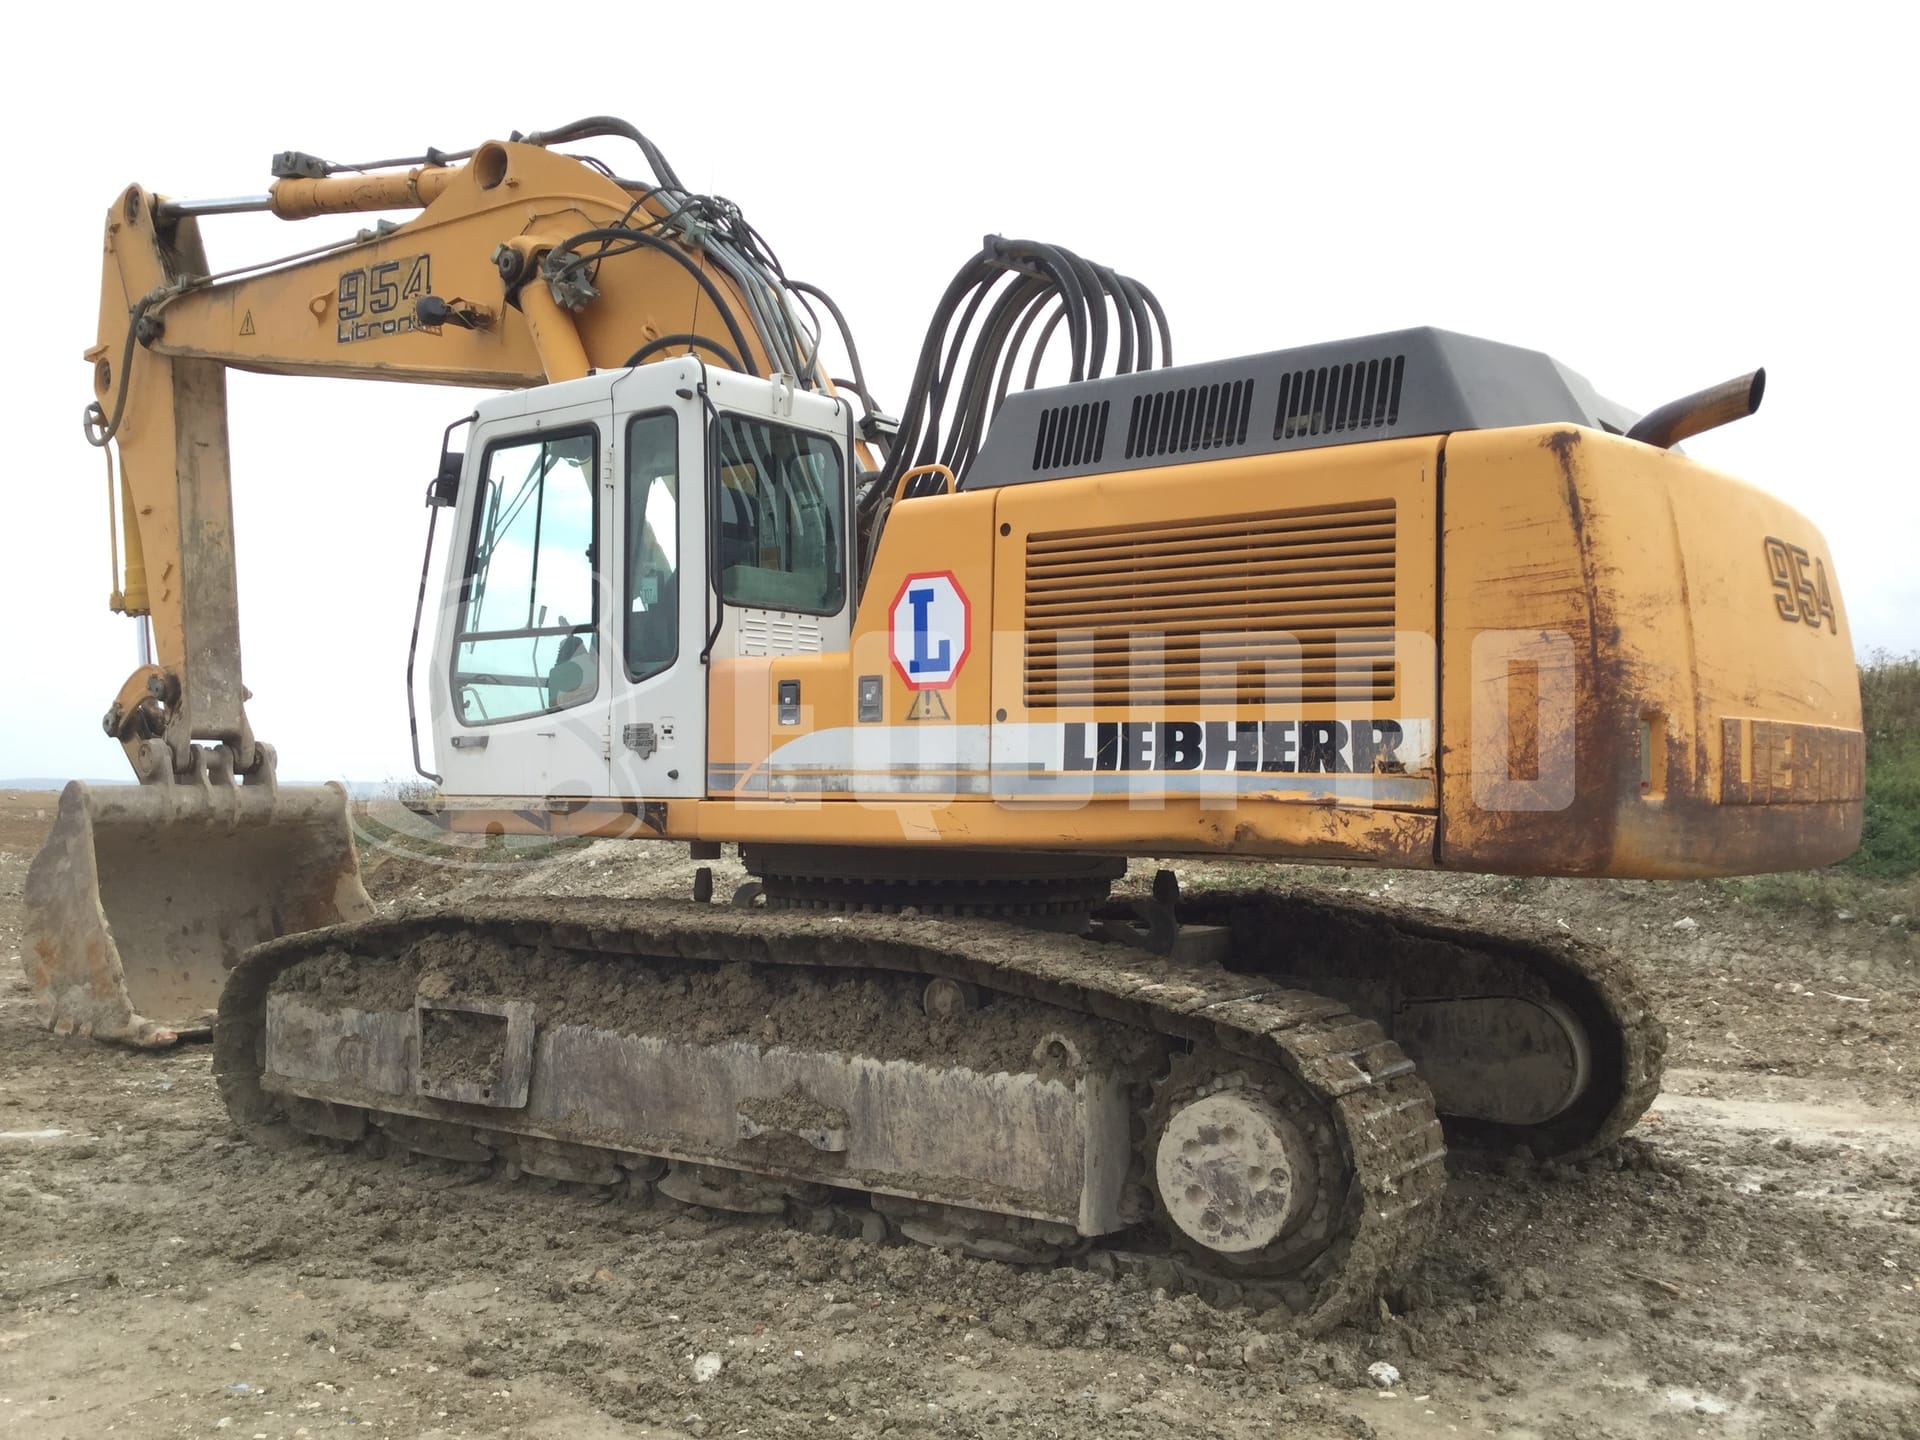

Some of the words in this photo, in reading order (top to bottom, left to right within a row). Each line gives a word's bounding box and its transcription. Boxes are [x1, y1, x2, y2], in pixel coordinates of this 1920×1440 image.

[338, 254, 432, 321] 954
[337, 315, 420, 344] Litron
[1764, 536, 1836, 635] 954
[909, 588, 950, 673] L
[1063, 719, 1406, 774] LIEBHERR
